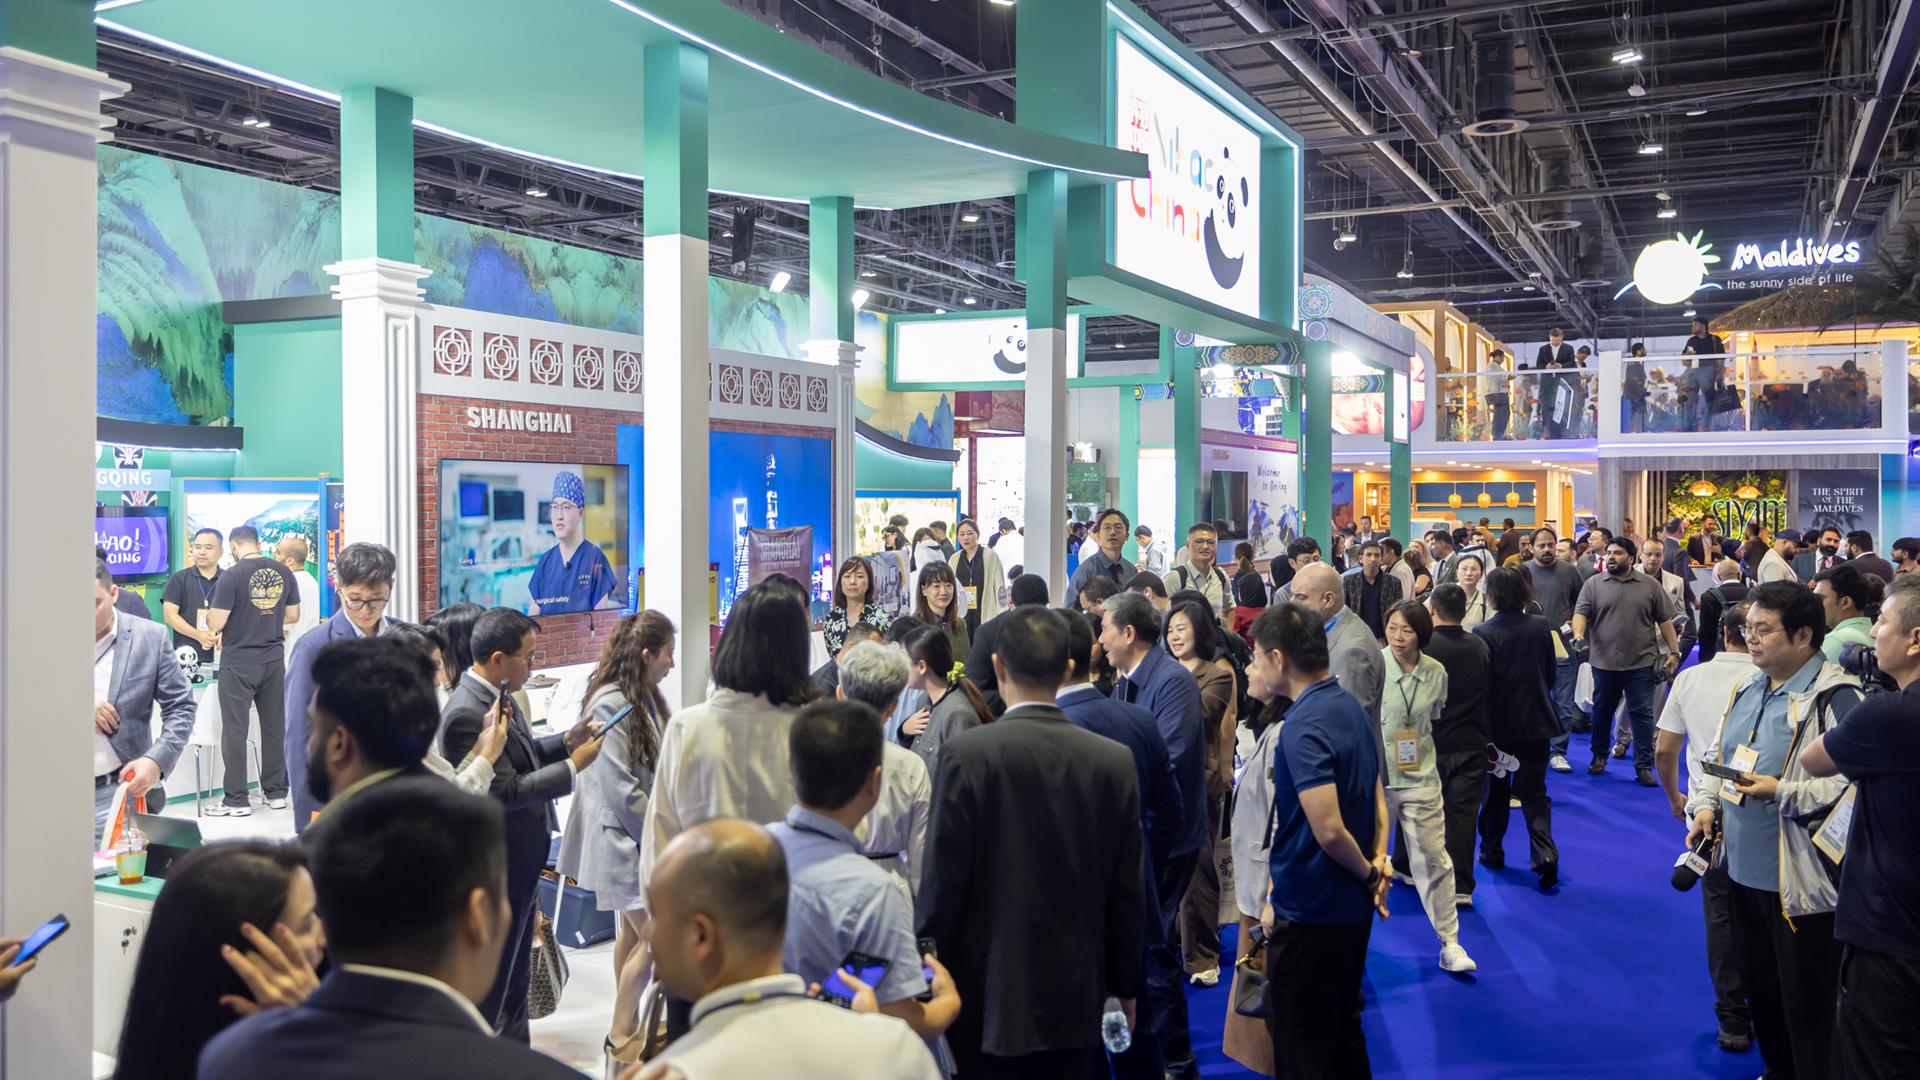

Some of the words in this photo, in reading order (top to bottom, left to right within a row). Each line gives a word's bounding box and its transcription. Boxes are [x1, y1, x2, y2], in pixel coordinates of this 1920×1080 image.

[1731, 238, 1860, 271] Maldives
[1727, 280, 1746, 289] the
[1750, 278, 1784, 289] sunny
[1788, 276, 1813, 286] side
[1818, 273, 1831, 285] of
[1835, 273, 1853, 283] life
[467, 406, 572, 433] SHANGHAI
[1812, 488, 1831, 496] THE
[1834, 488, 1865, 496] SPIRIT
[1812, 504, 1864, 513] MALDIVES
[107, 552, 141, 564] QING
